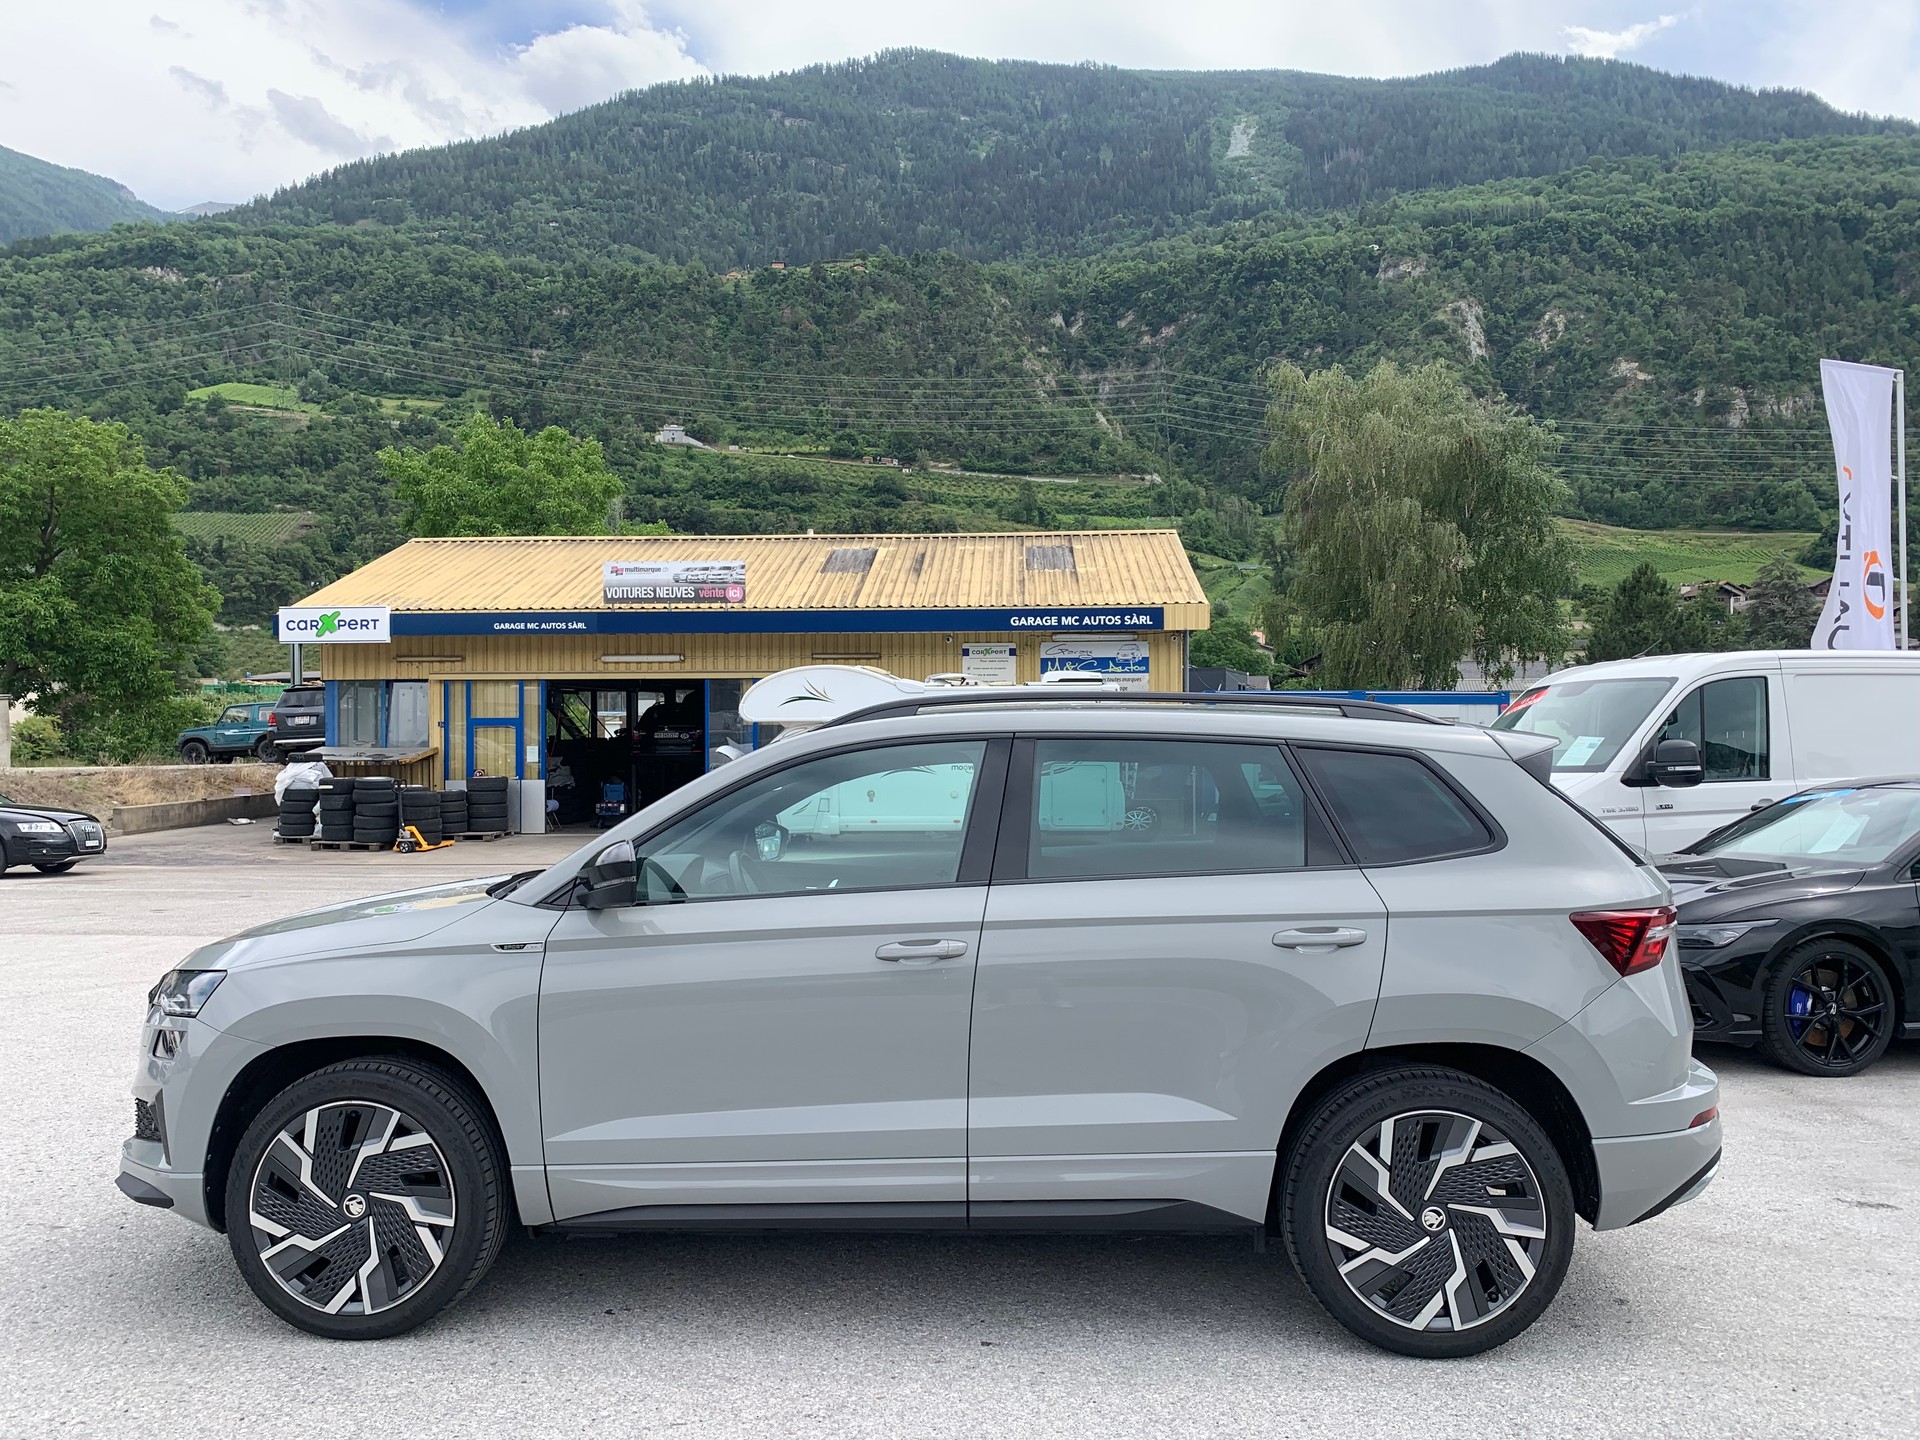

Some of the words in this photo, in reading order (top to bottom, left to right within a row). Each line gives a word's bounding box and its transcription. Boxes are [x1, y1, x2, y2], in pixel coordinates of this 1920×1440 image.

[606, 586, 654, 599] VOITURES
[656, 586, 695, 598] NEUVES
[698, 587, 724, 598] vente
[729, 587, 741, 598] ici
[493, 622, 525, 630] GARAGE
[1010, 616, 1058, 626] GARAGE
[1061, 616, 1080, 626] MC
[1082, 615, 1121, 625] AUTOS
[1124, 613, 1153, 625] SÀRL
[1048, 658, 1061, 672] M
